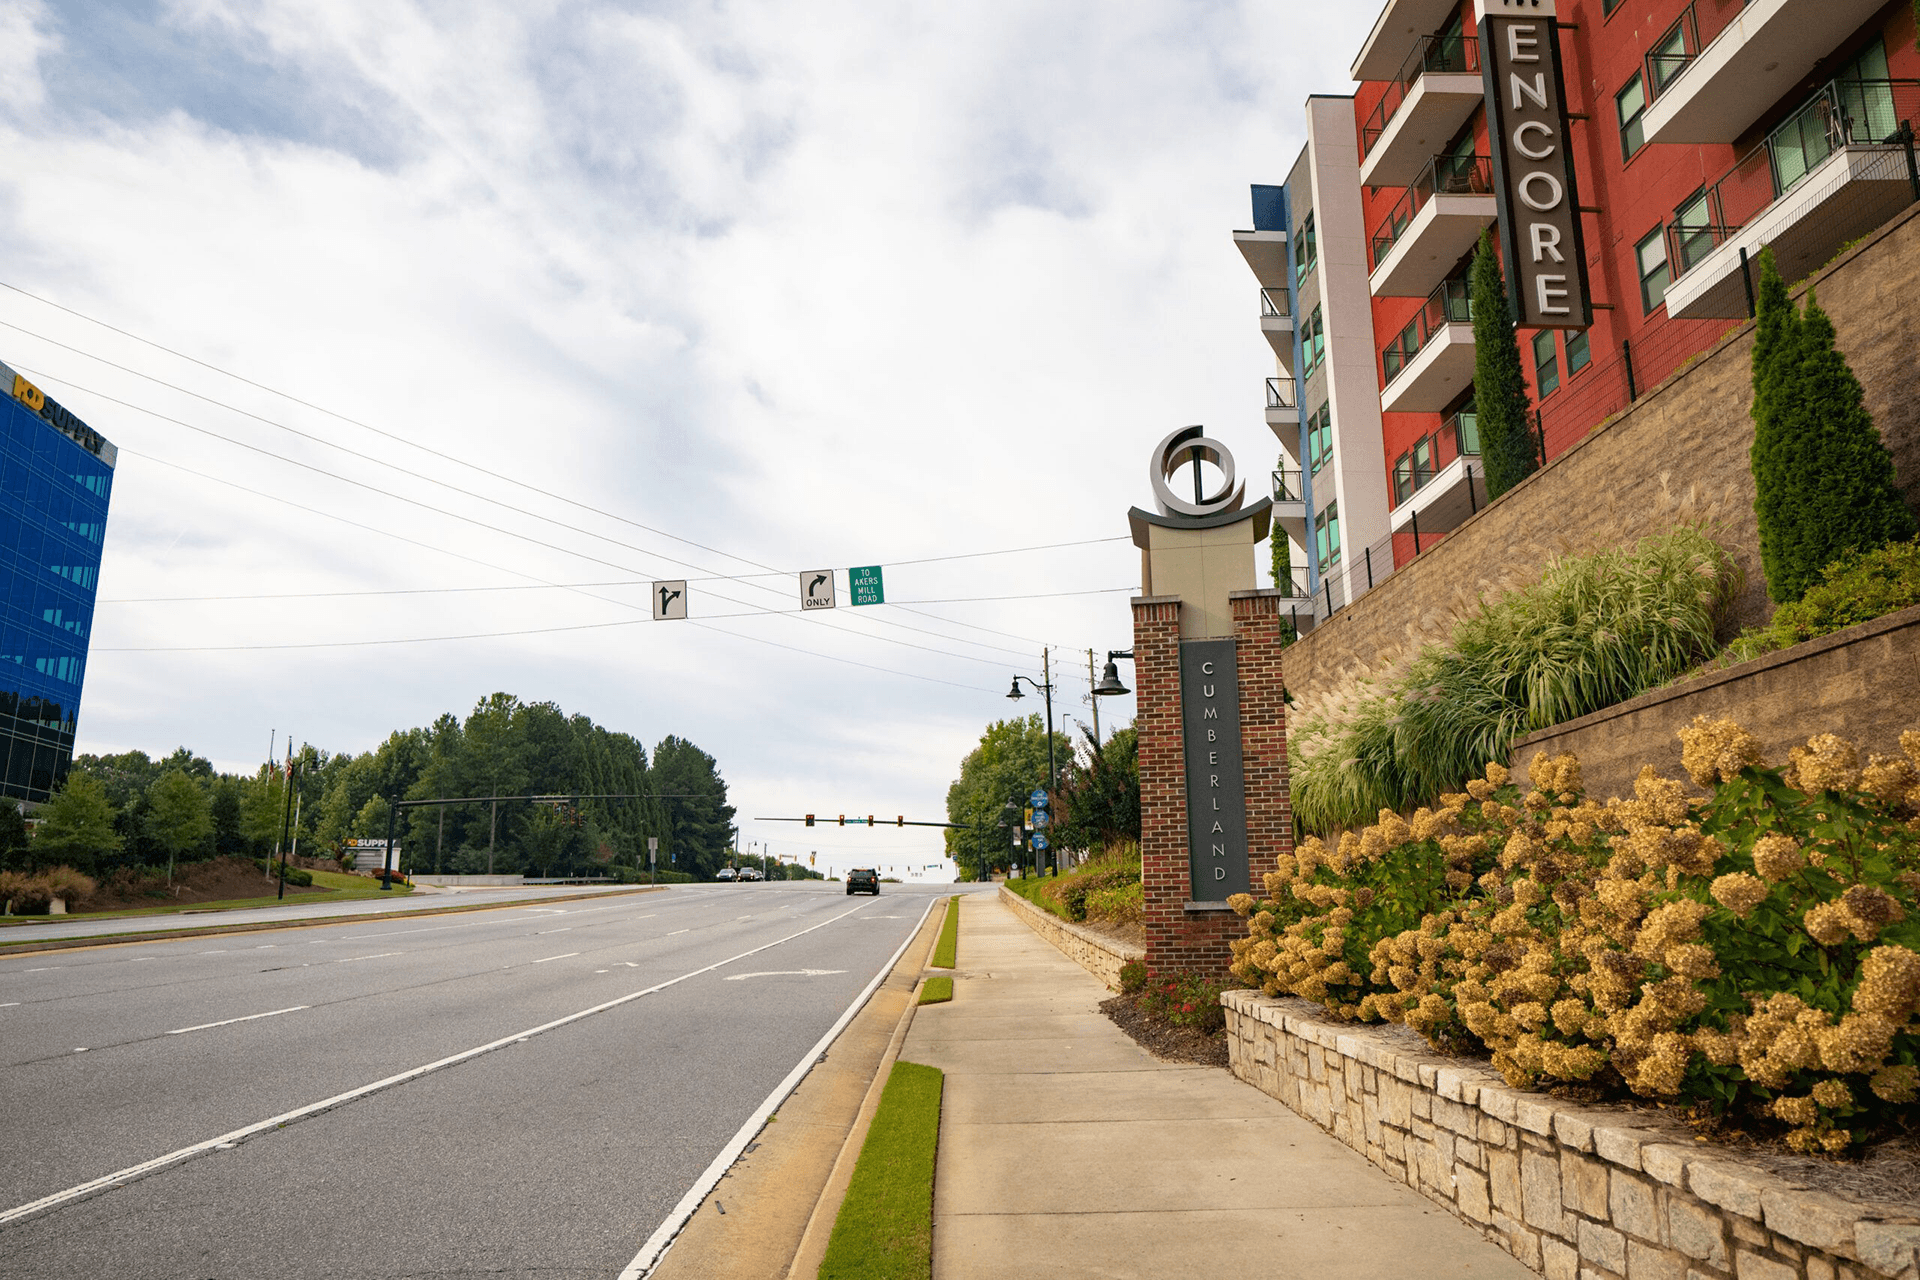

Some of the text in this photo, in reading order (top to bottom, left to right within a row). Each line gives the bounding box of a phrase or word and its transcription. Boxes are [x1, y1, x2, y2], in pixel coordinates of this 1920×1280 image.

[1507, 24, 1570, 315] ENCORE
[13, 374, 107, 455] HD SUPPLY
[860, 568, 870, 577] TO
[854, 577, 879, 586] AKERS
[858, 586, 876, 595] MILL
[806, 597, 831, 607] ONLY
[858, 594, 878, 603] ROAD
[1201, 661, 1226, 881] CUMBERLAND
